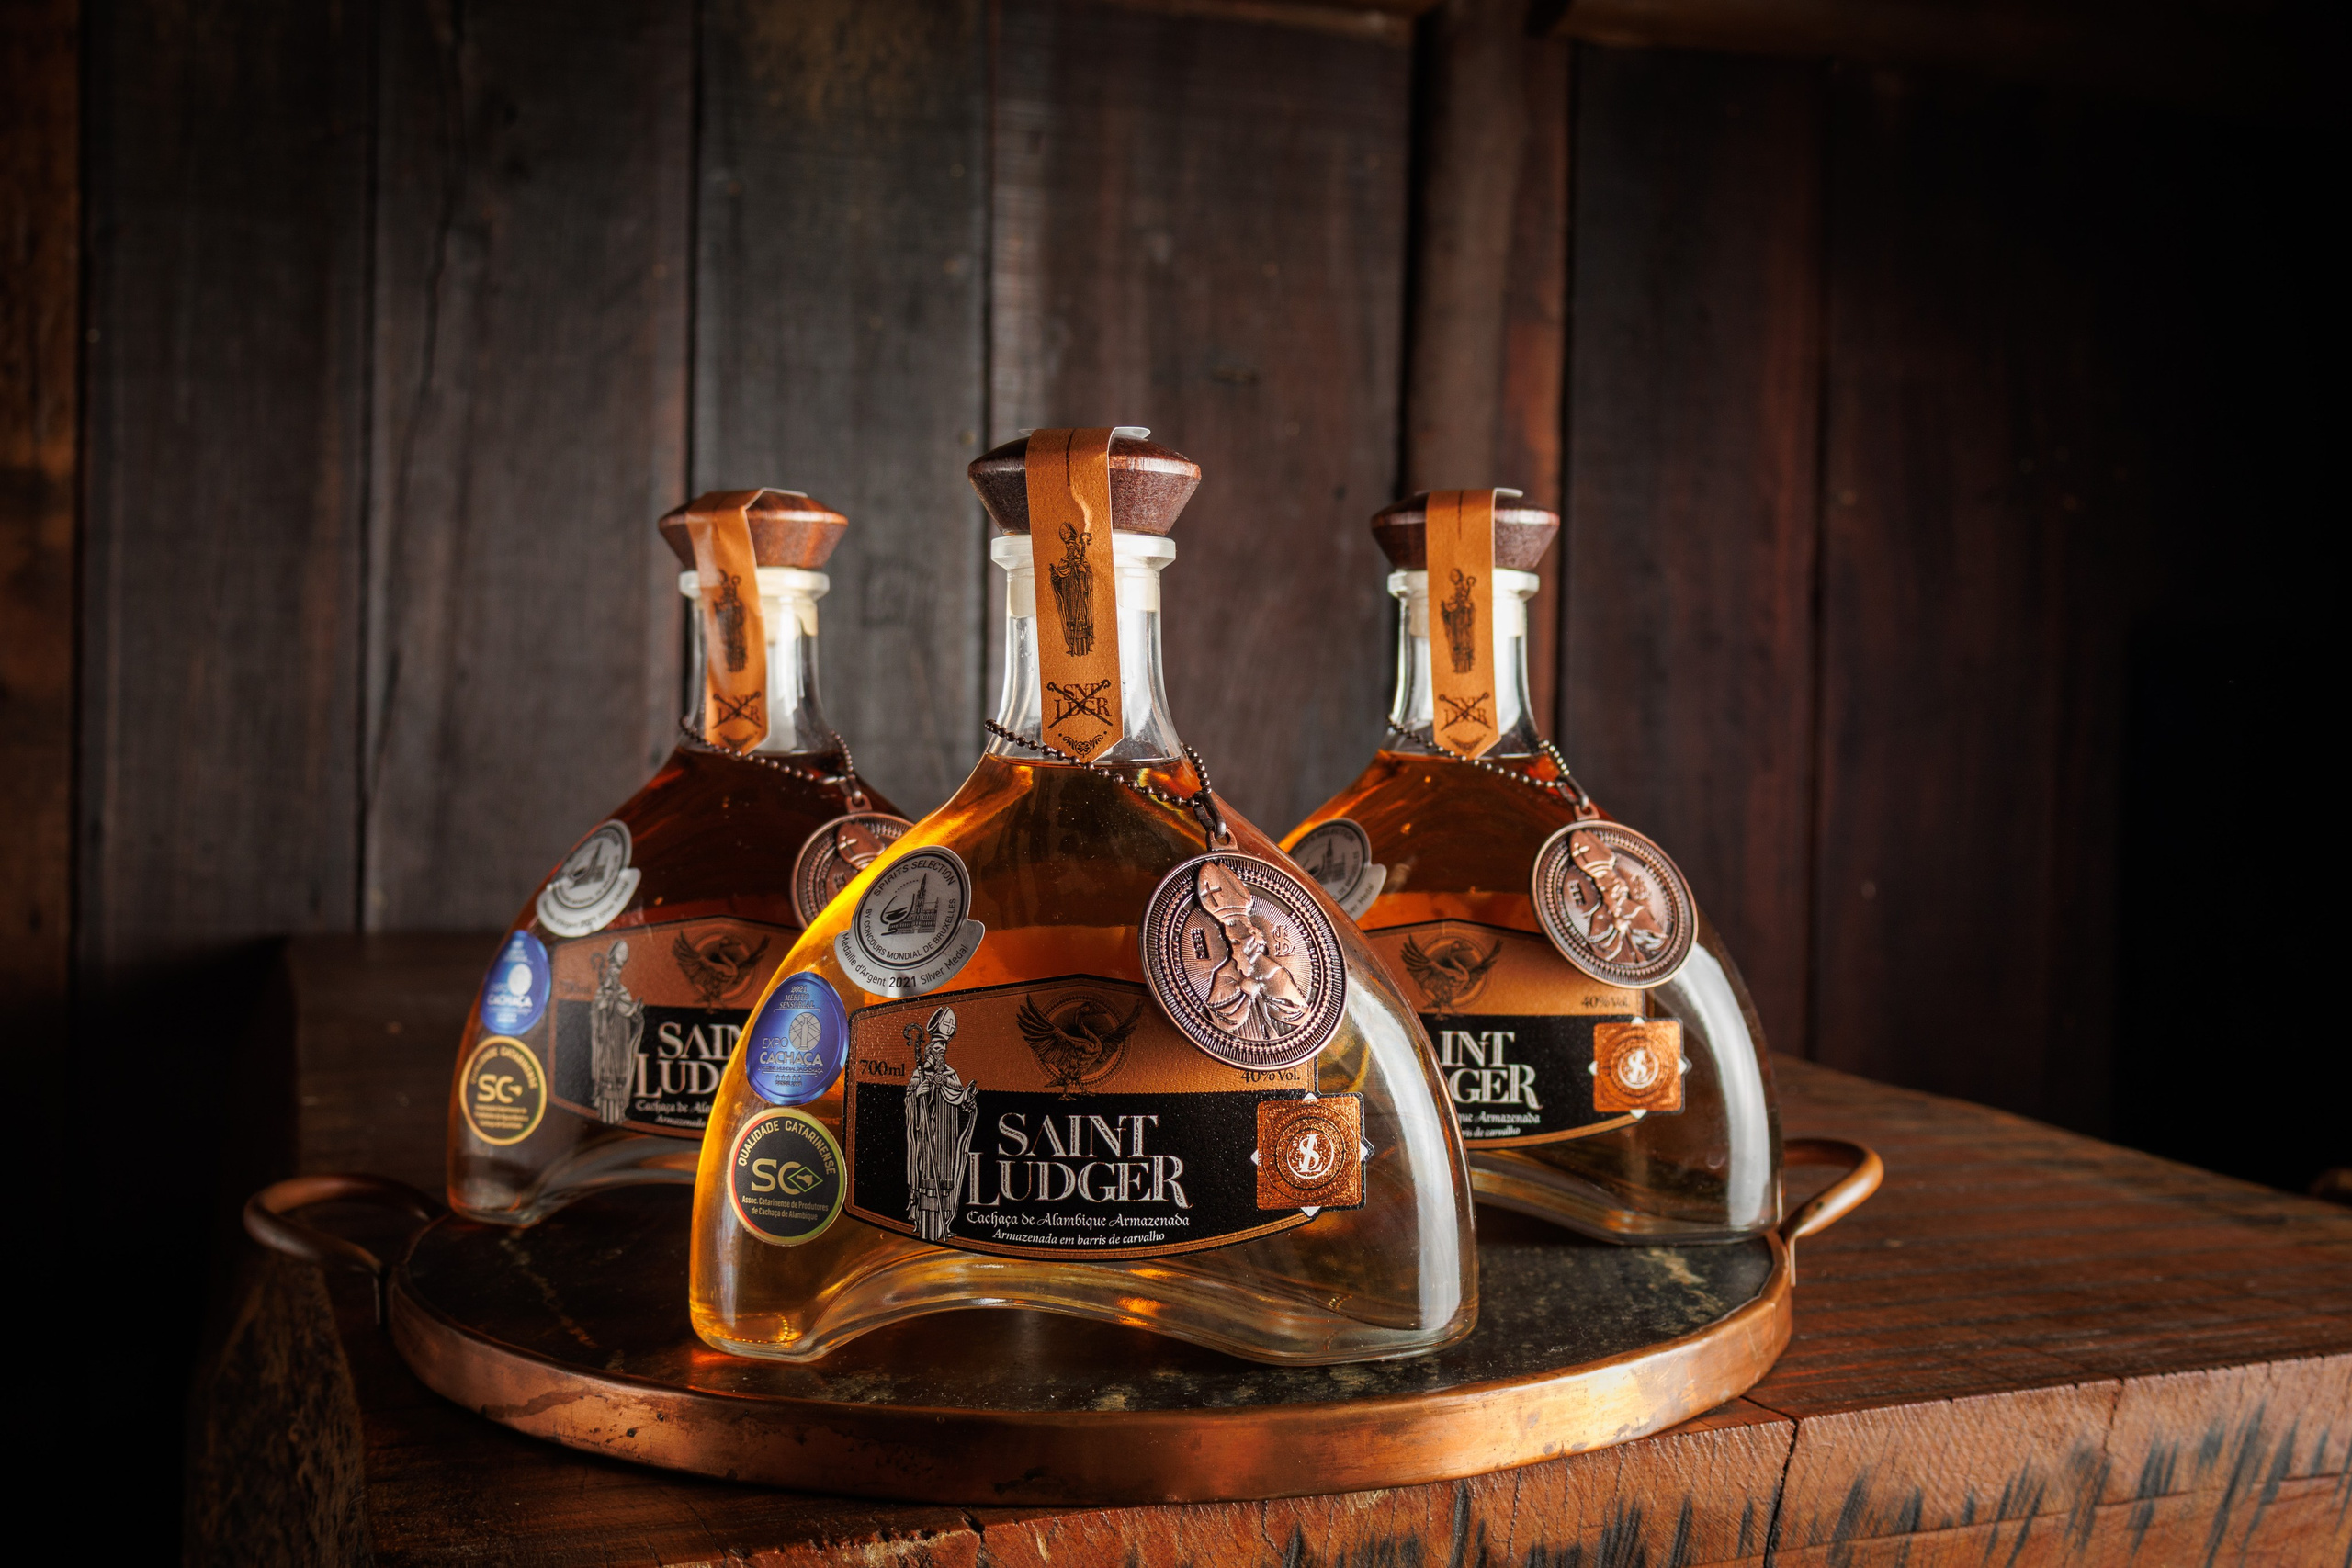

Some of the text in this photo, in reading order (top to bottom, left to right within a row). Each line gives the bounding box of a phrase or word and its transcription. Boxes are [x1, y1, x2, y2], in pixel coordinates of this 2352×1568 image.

[874, 860, 956, 897] SPIRITS SELECTION
[864, 898, 956, 961] BY CONCOURS MONDIAL DE BRUXELLES
[841, 932, 969, 988] Médaille d'Argent 2021 Silver Medal
[791, 985, 807, 993] 2021
[779, 1000, 815, 1009] SENSORIAL
[762, 1037, 788, 1049] EXPO
[1439, 1031, 1515, 1067] INT
[759, 1052, 823, 1066] CACHAÇA
[634, 1053, 724, 1098] LUD
[1277, 1067, 1300, 1081] Vol.
[1449, 1064, 1544, 1110] GER
[738, 1120, 837, 1175] QUALIDADE CATARINENSE
[998, 1112, 1159, 1157] SAINT
[966, 1151, 1193, 1209] LUDGER
[741, 1195, 829, 1212] Assoc. Catarinense de Produtores
[759, 1207, 781, 1219] Cachaça
[782, 1210, 788, 1218] de
[788, 1211, 819, 1221] Alambique
[967, 1210, 1190, 1230] Cachaça de Alambique Armazenada
[992, 1228, 1165, 1246] Armazenada em barris de carvalho
